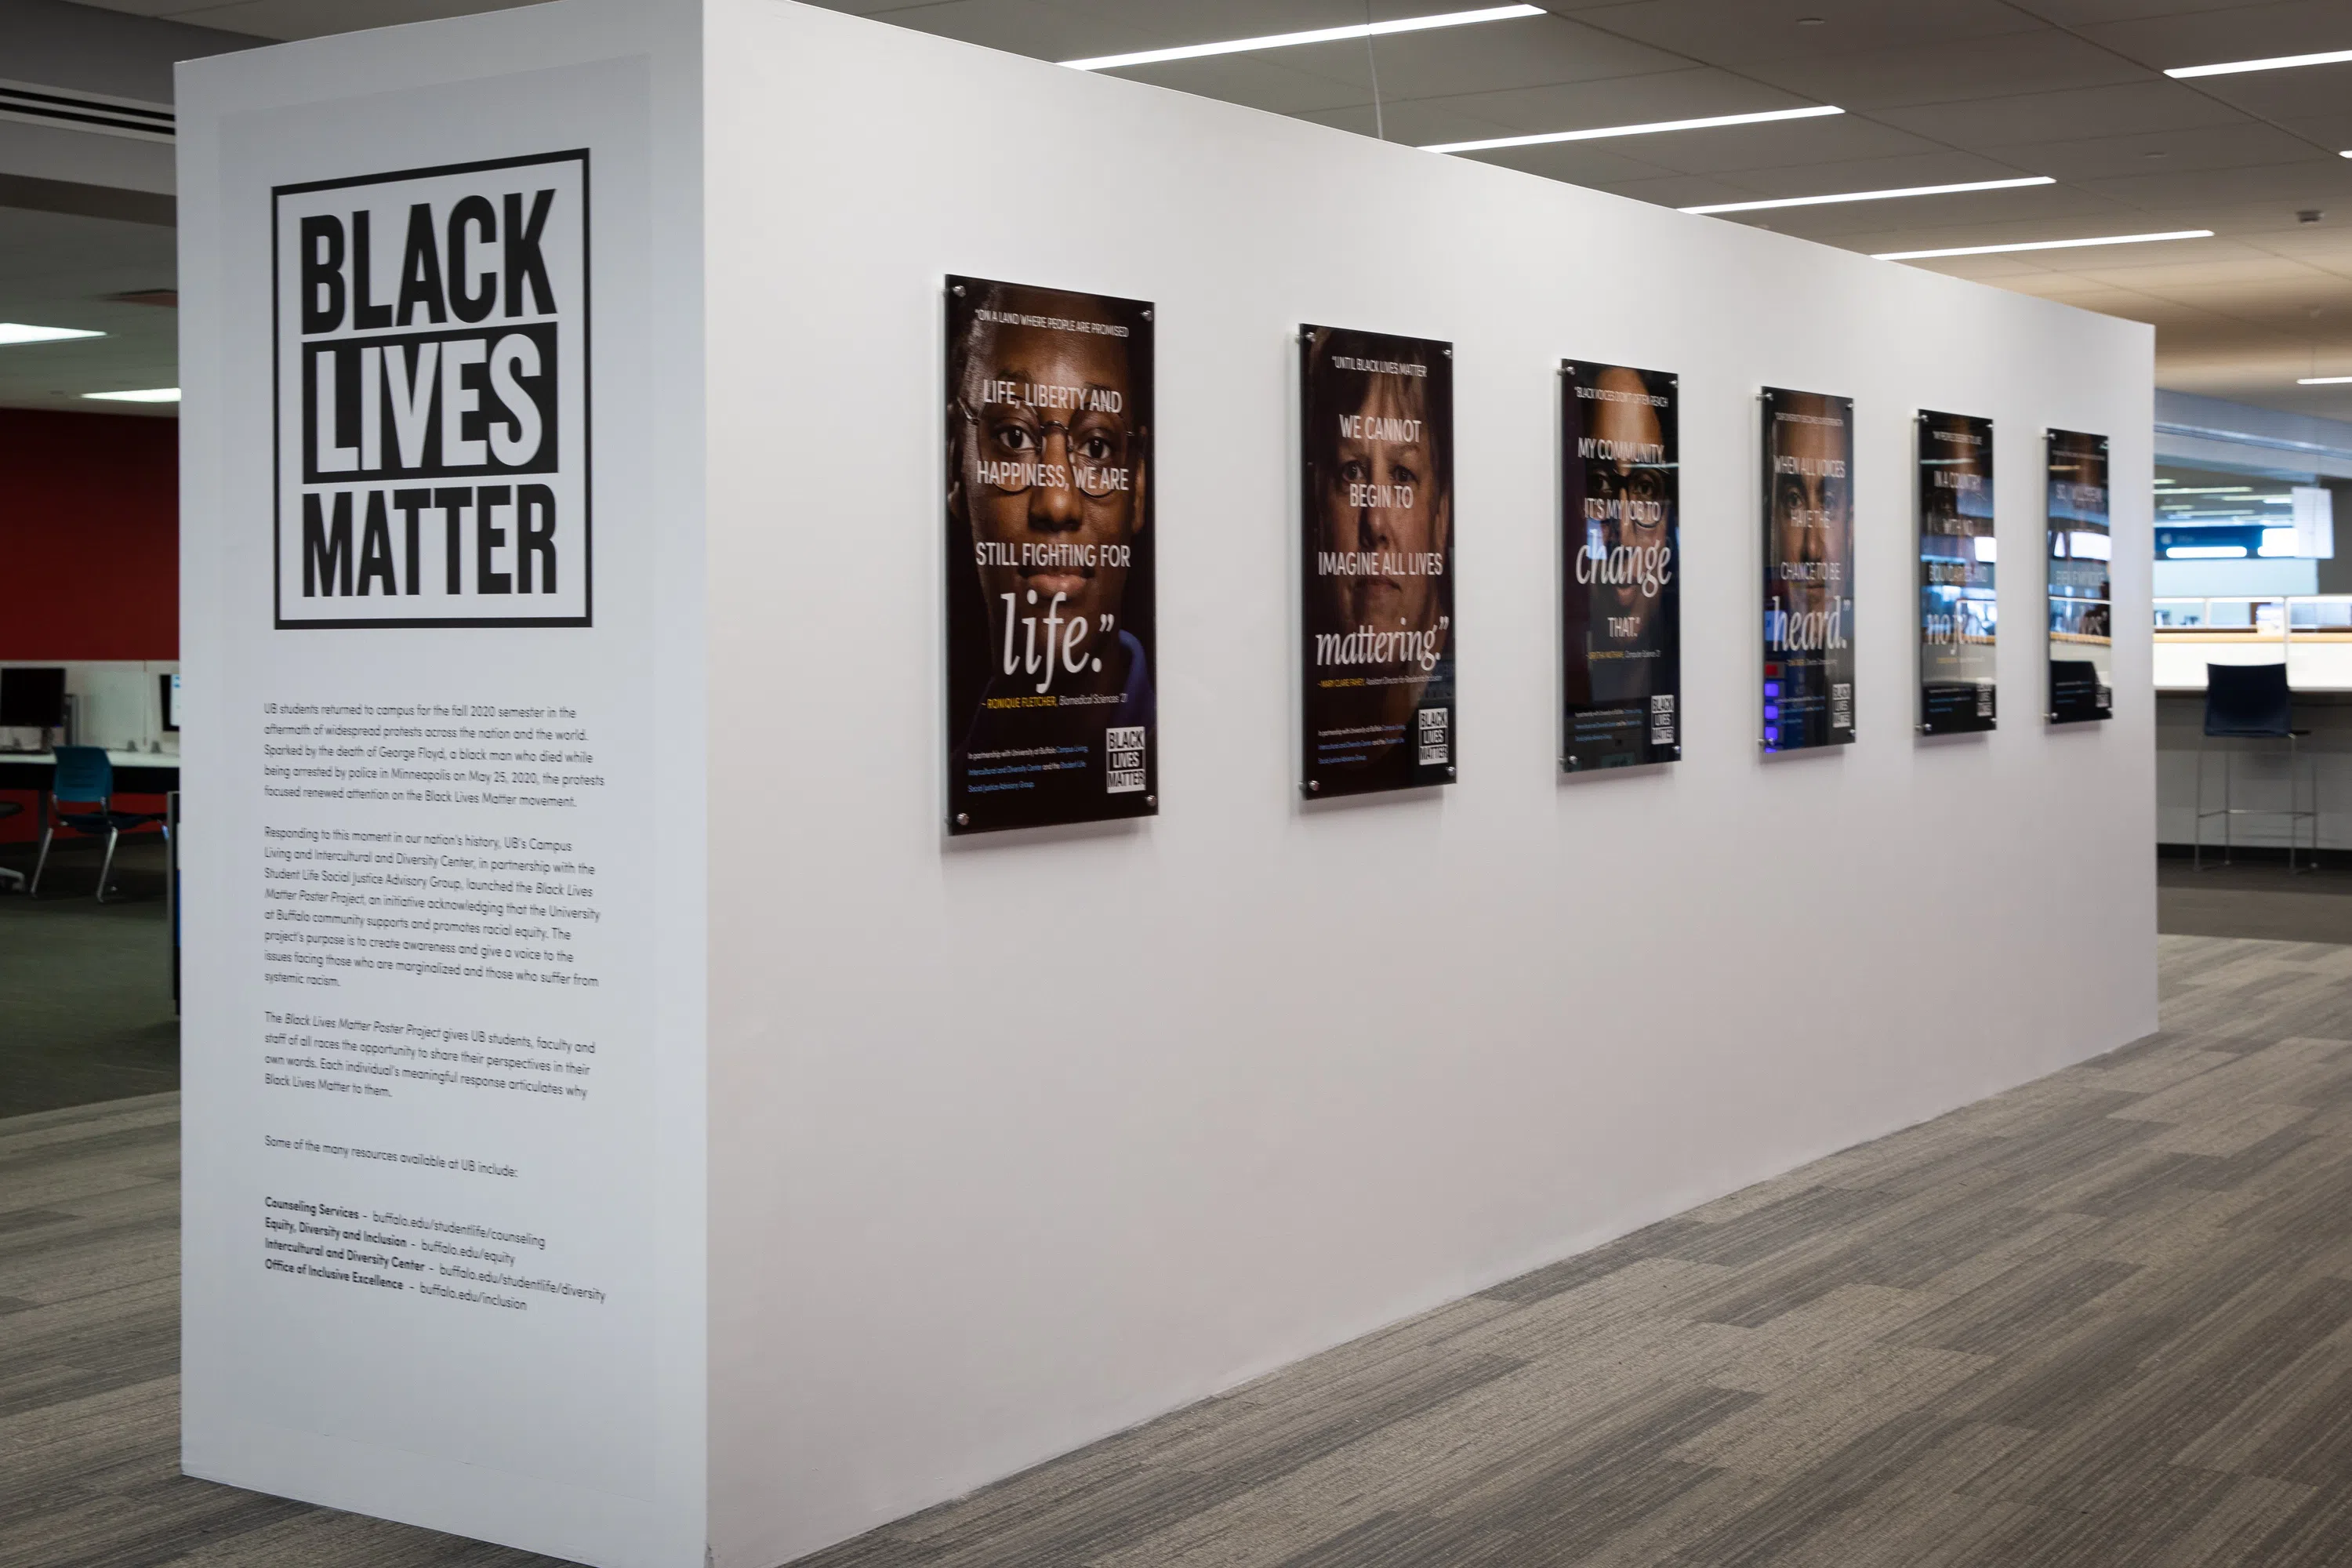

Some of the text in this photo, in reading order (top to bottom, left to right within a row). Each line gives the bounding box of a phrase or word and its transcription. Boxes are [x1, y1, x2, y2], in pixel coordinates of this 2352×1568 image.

[299, 189, 558, 335] BLACK
[999, 312, 1019, 325] LAND
[1020, 314, 1047, 328] WHERE
[1047, 318, 1076, 332] PEOPLE
[1076, 321, 1091, 333] ARE
[1091, 323, 1129, 337] PROMISED
[1356, 358, 1380, 372] BLACK
[1380, 361, 1399, 374] LIVES
[1399, 363, 1427, 377] MATTER
[316, 333, 543, 473] LIVES
[983, 379, 1123, 413] LIFE, LIBERTY AND
[1339, 413, 1421, 443] WE CANNOT
[1578, 437, 1597, 459] MY
[977, 460, 1129, 492] HAPPINESS, WE ARE
[1773, 455, 1846, 478] WHEN ALL VOICES
[1349, 483, 1414, 509] BEGIN TO
[1606, 499, 1622, 519] MY
[1624, 500, 1645, 526] JOB
[1645, 501, 1661, 522] TO
[302, 484, 557, 597] MATTER
[976, 542, 1131, 568] STILL FIGHTING FOR
[1319, 551, 1443, 575] IMAGINE ALL LIVES
[1576, 528, 1672, 597] change
[1780, 561, 1841, 580] CHANCE TO BE
[1000, 589, 1115, 694] life.”
[1315, 615, 1449, 671] mattering.”
[264, 703, 576, 718] UB students returned to campus for the fall 2020 semester in the
[987, 697, 1021, 710] RONIQUE
[1058, 695, 1093, 706] Biomedical
[1094, 693, 1119, 704] Sciences
[1420, 712, 1447, 728] BLACK
[1109, 731, 1145, 749] BLACK
[1424, 729, 1444, 744] LIVES
[1112, 751, 1140, 768] LIVES
[1420, 746, 1447, 760] MATTER
[1108, 771, 1145, 787] MATTER
[264, 786, 301, 797] focused
[303, 788, 344, 798] renewed
[346, 789, 390, 800] attention
[406, 790, 423, 801] the
[425, 790, 452, 802] Black
[455, 792, 480, 804] Lives
[482, 793, 517, 804] Matter
[519, 797, 576, 807] movement.
[264, 827, 572, 853] Responding to this moment in our nation's history, UB's Campus
[264, 868, 593, 896] Student Life Social Justice Advisory Group, launched the Black Lives
[265, 1074, 392, 1096] Black Lives Matter to them.
[265, 1135, 518, 1177] Some of the many resources available at UB include:
[264, 1197, 546, 1249] Counseling Services buffalo.edu/studentlife/counseling
[265, 1218, 515, 1267] Equity, Diversity and Inclusion buffalo.edu/equity
[265, 1237, 606, 1303] Intercultural and Diversity Center buffalo.edu/studentlife/diversity
[265, 1258, 527, 1310] Office of Inclusive Excellence buffalo.edu/inclusion
